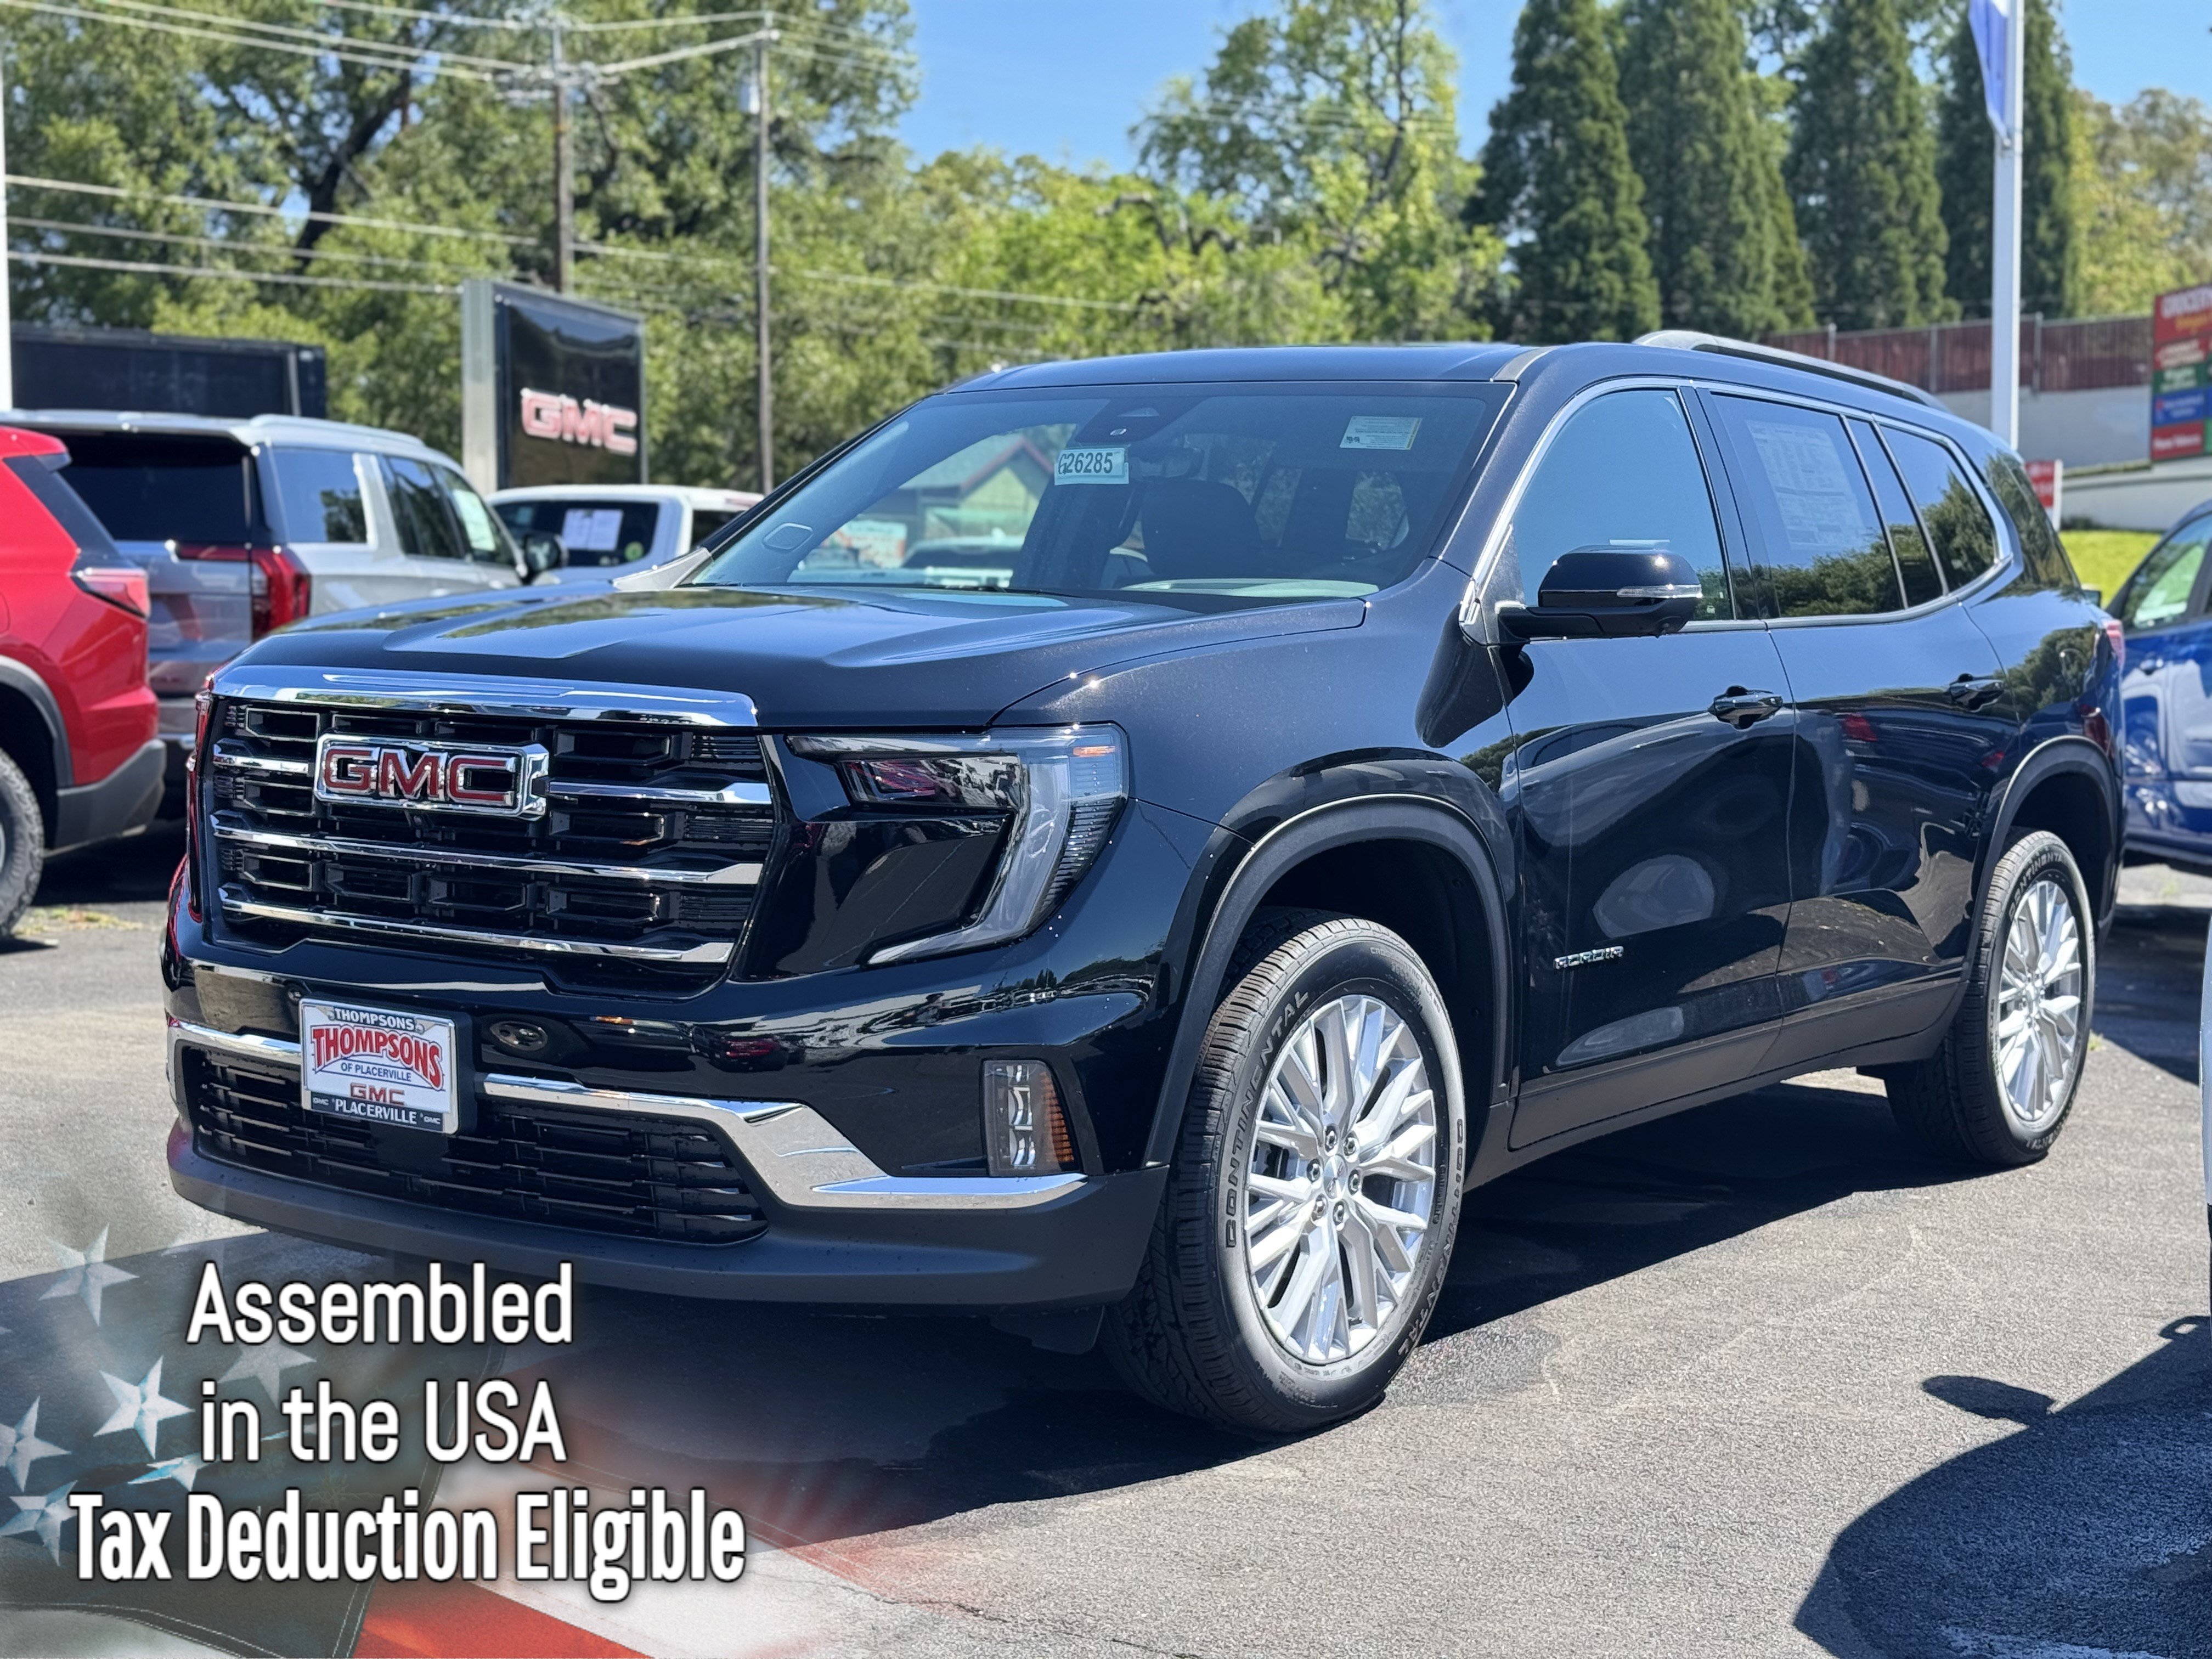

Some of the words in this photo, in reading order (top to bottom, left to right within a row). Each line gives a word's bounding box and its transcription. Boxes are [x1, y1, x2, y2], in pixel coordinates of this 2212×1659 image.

[520, 387, 637, 457] GMC
[324, 746, 516, 806] GMC
[1553, 946, 1624, 969] ACADIA
[333, 1007, 415, 1031] THOMPSONS
[312, 1025, 443, 1090] THOMPSONS
[341, 1062, 353, 1072] OF
[355, 1064, 412, 1082] PLACERVILLE
[350, 1082, 405, 1106] GMC
[313, 1097, 329, 1106] GMC
[334, 1098, 417, 1125] PLACERVILLE
[424, 1116, 441, 1125] GMC
[1225, 991, 1309, 1248] CONTINENTAL
